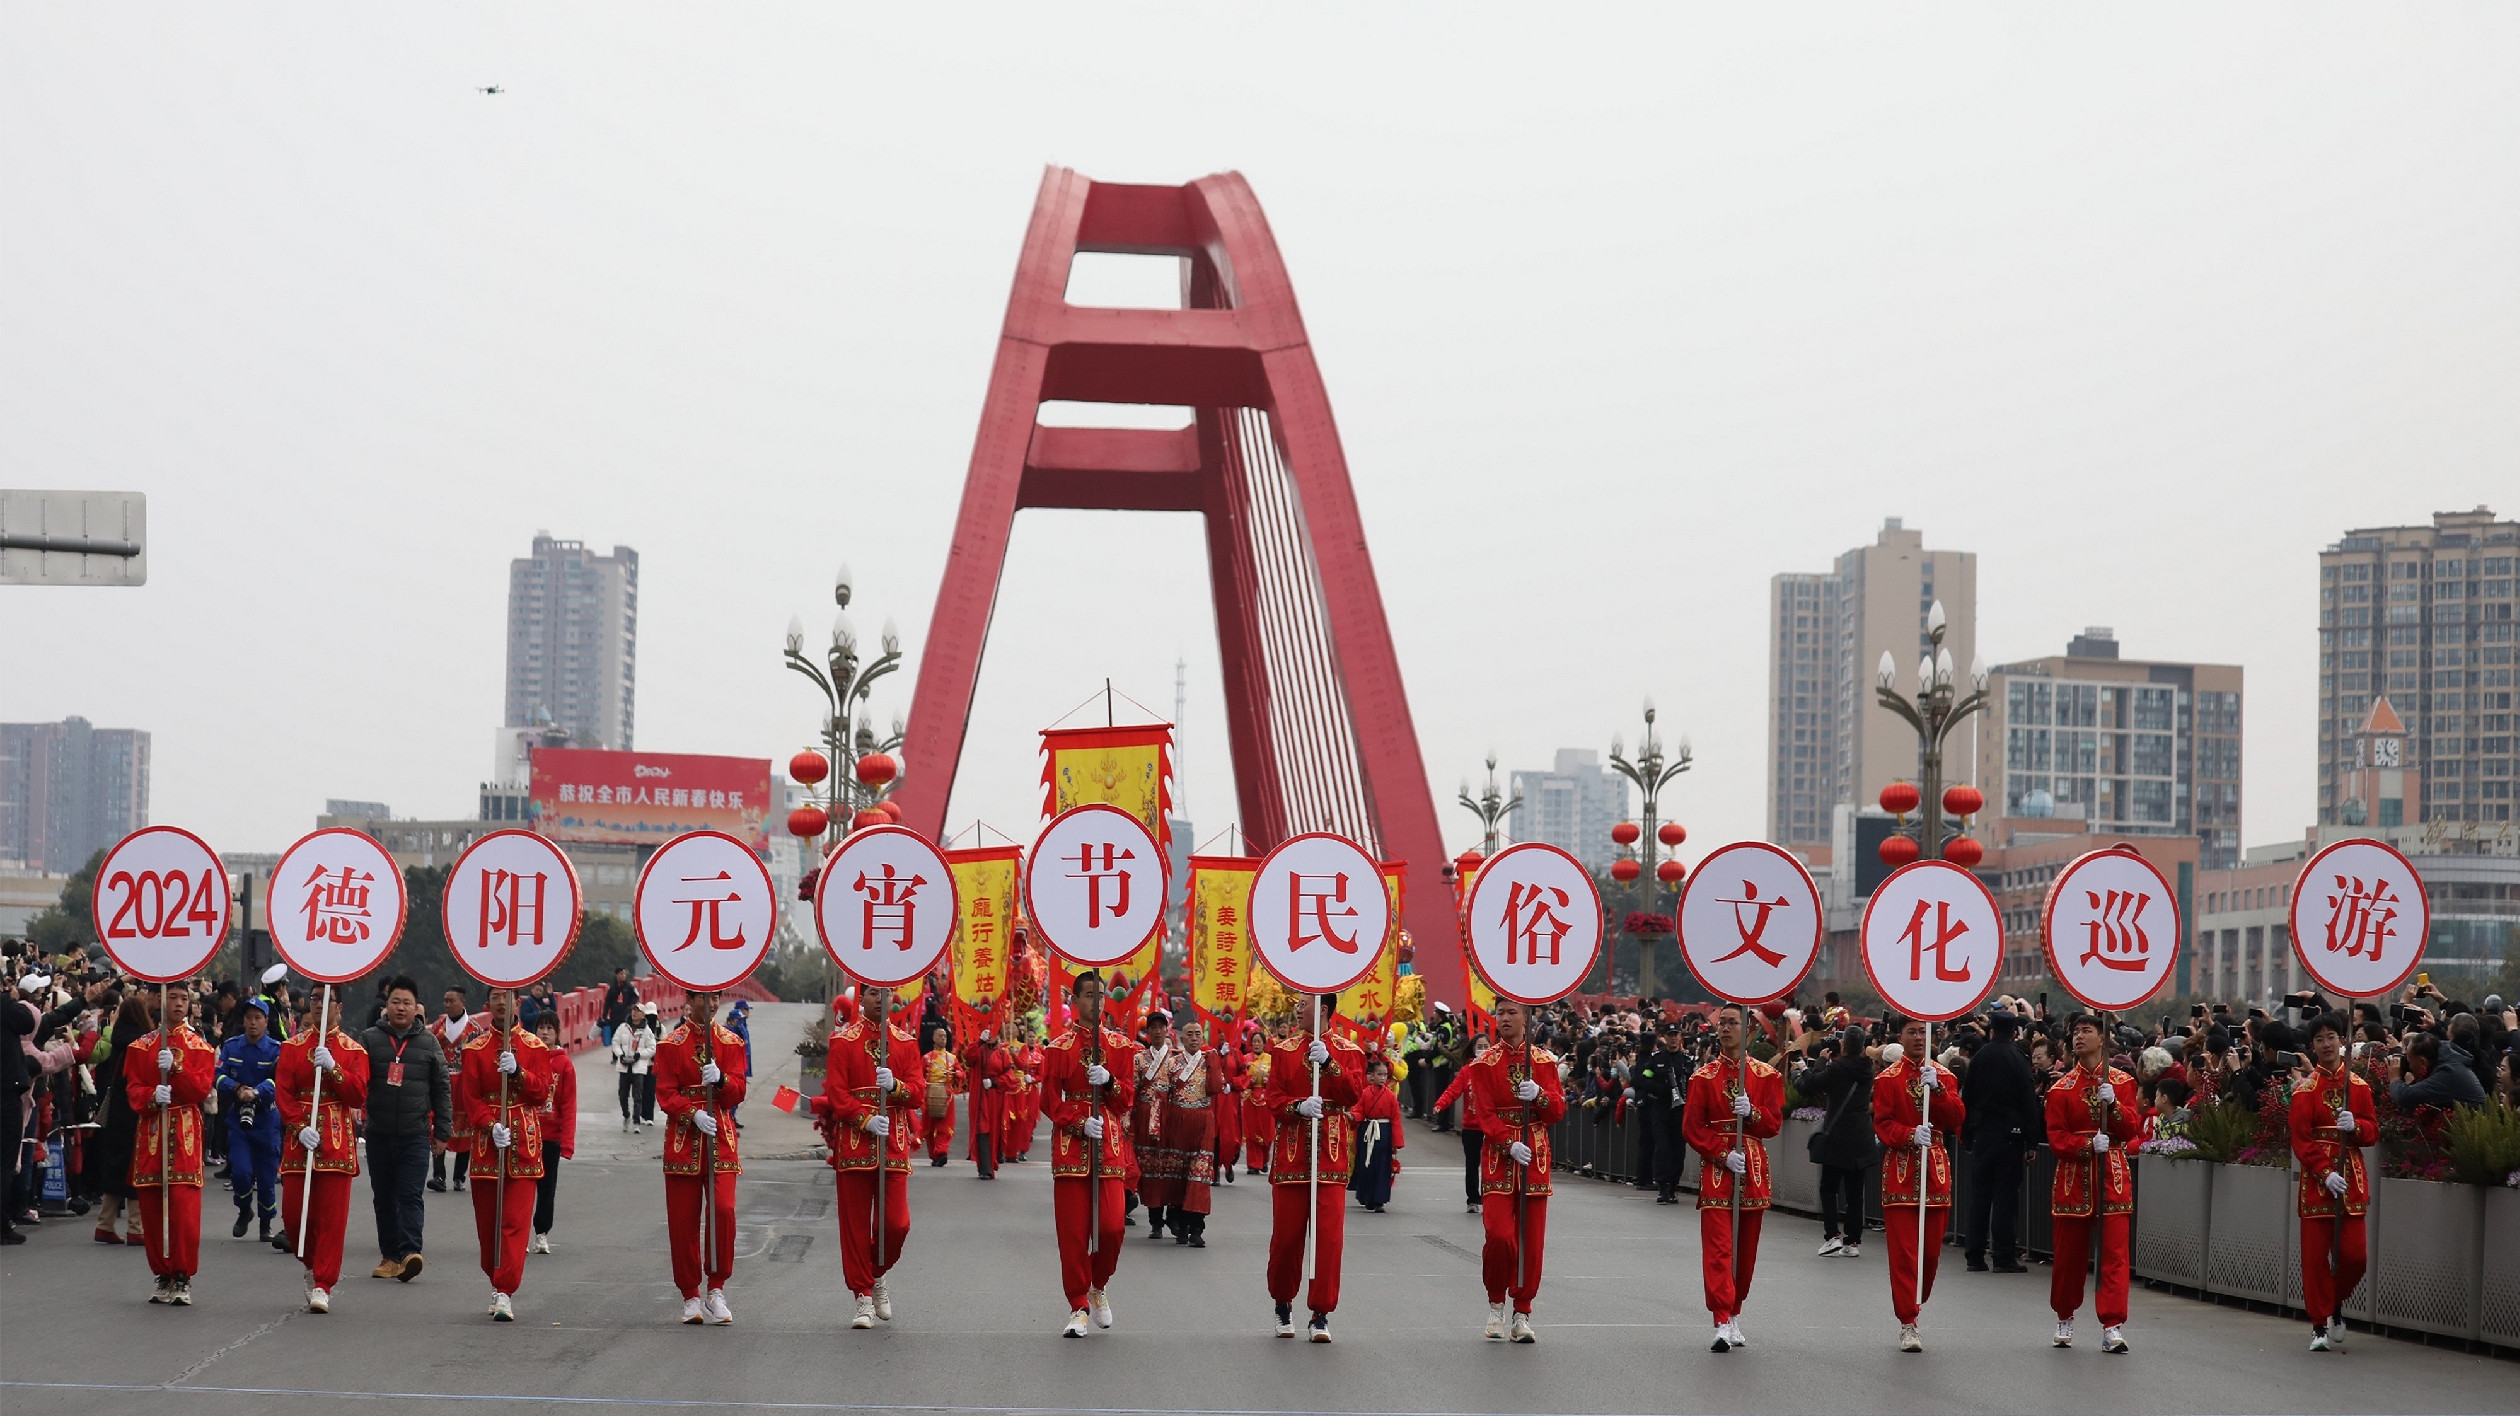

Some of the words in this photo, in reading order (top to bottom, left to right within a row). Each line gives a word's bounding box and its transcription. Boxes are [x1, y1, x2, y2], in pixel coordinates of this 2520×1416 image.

[559, 784, 744, 810] 恭祝全市人民新春快乐
[108, 869, 218, 939] 2024
[301, 864, 374, 944] 德
[479, 869, 547, 948] 阳
[673, 871, 745, 951] 元
[853, 864, 927, 951] 宵
[1062, 843, 1135, 928] 节
[1288, 872, 1358, 954] 民
[1500, 881, 1572, 965] 俗
[1712, 880, 1790, 968] 文
[2325, 875, 2399, 961] 游
[971, 897, 995, 993] 龐行養姑
[1215, 905, 1239, 1003] 姜詩孝親
[1897, 899, 1971, 982] 化
[2080, 890, 2150, 971] 巡
[45, 1181, 62, 1190] POLICE
